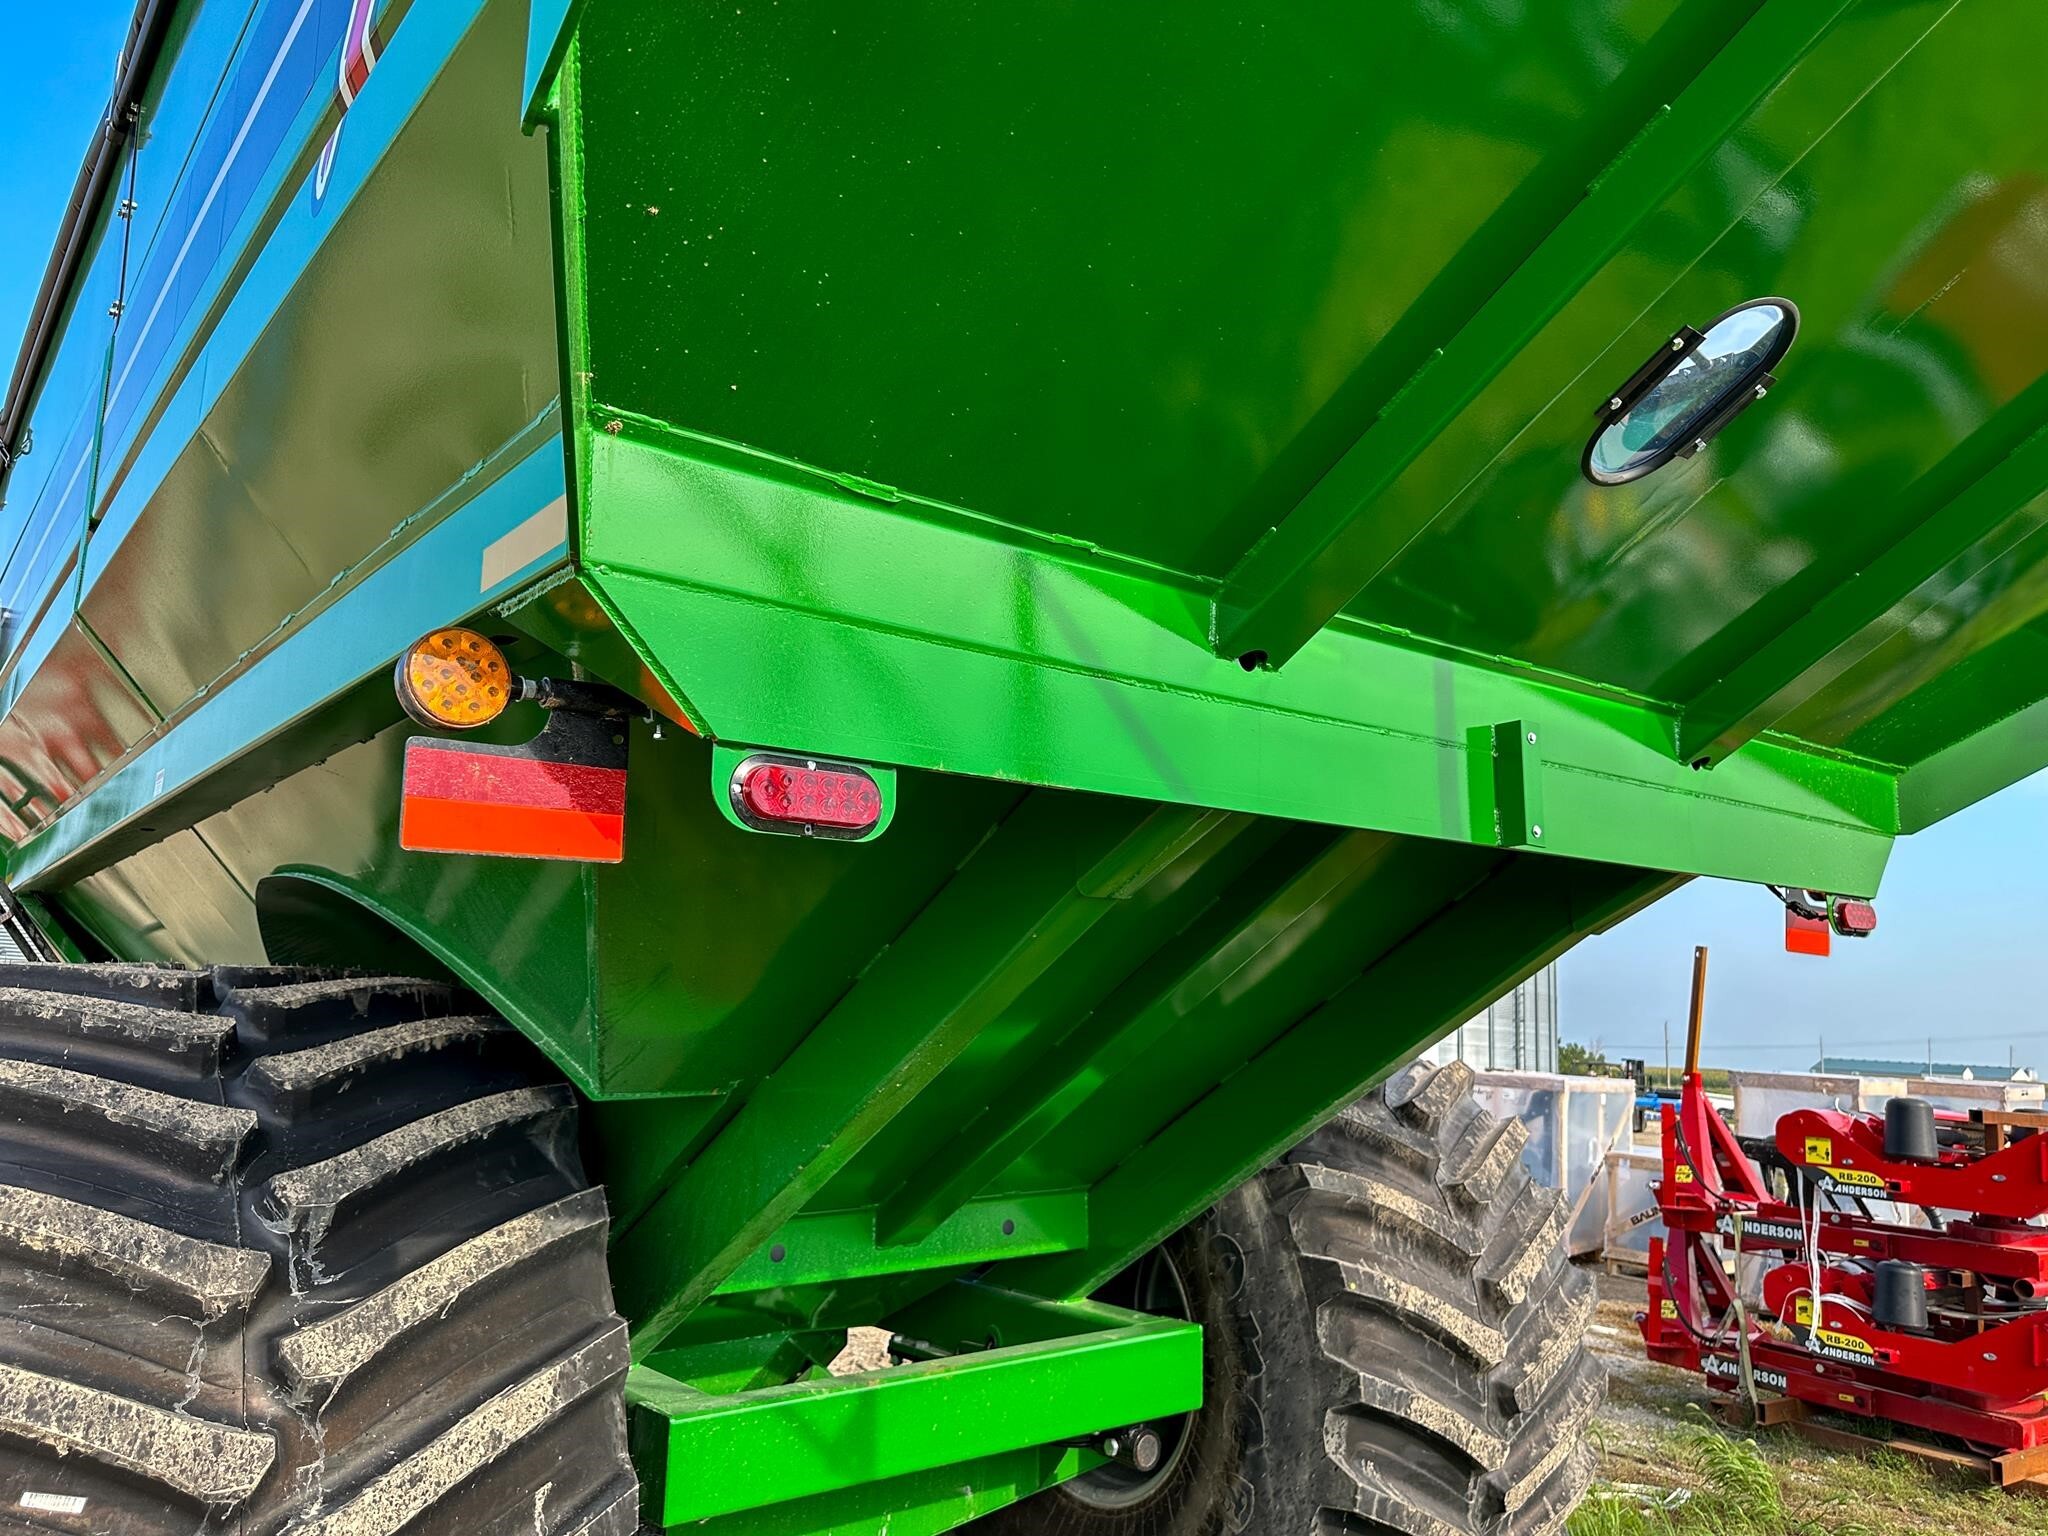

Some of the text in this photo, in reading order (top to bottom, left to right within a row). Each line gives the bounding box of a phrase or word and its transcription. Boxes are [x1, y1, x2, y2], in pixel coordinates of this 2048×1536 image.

[1839, 1172, 1877, 1184] RB-200
[1834, 1184, 1888, 1199] ANDERSON
[1740, 1220, 1803, 1240] NDERSON
[1826, 1334, 1865, 1350] RB-200
[1821, 1346, 1875, 1366] ANDERSON
[1719, 1361, 1787, 1388] ANRSON
